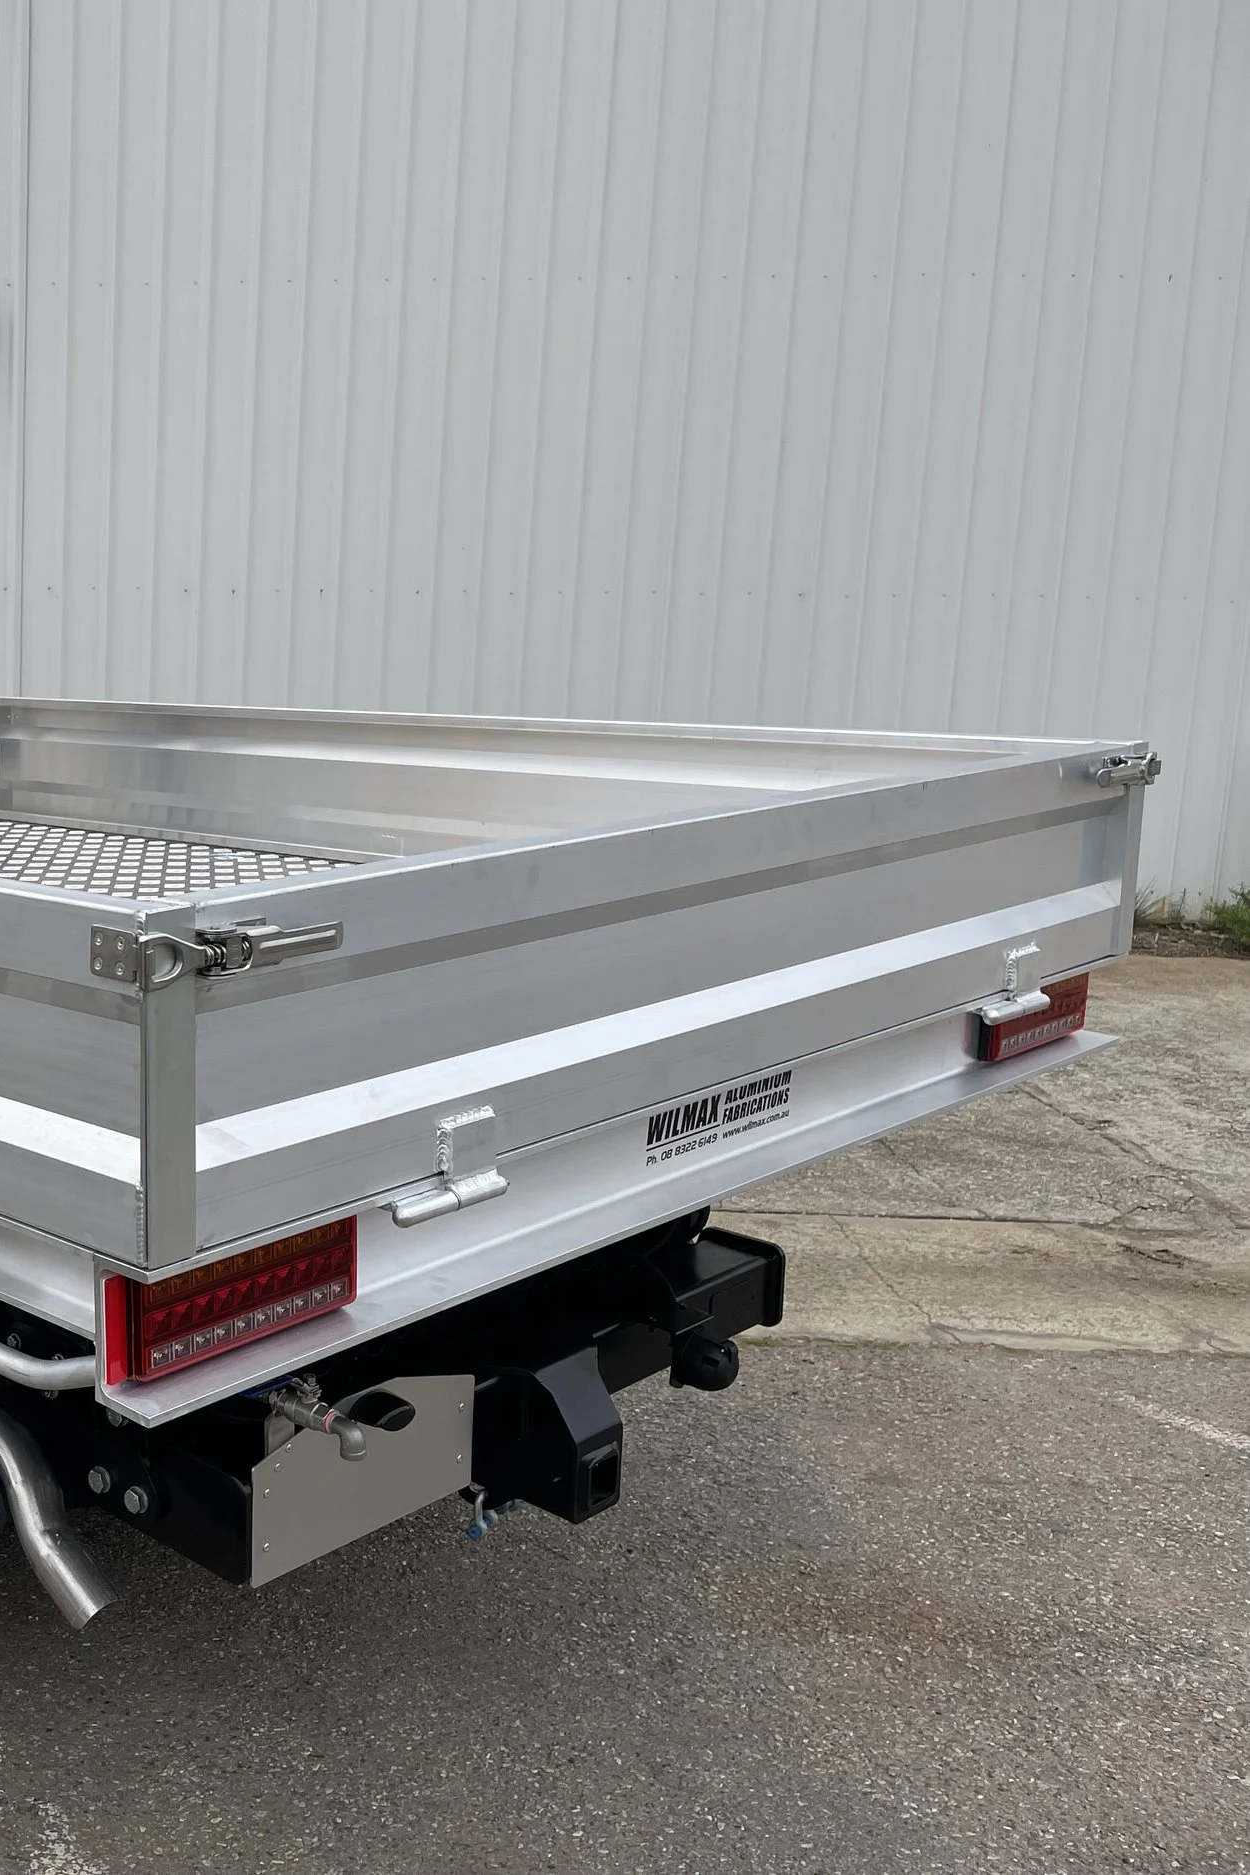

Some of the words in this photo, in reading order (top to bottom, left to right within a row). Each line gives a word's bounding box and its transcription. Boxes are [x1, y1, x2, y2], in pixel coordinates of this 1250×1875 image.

[722, 1087, 791, 1125] FABRICATIONS
[724, 1069, 793, 1105] ALUMINIUM
[646, 1093, 722, 1147] WILMAX
[646, 1156, 658, 1167] Ph.
[661, 1149, 673, 1161] 08
[675, 1139, 697, 1156] 8322
[698, 1133, 718, 1148] 6149
[722, 1109, 790, 1140] www.wilmax.com.au
